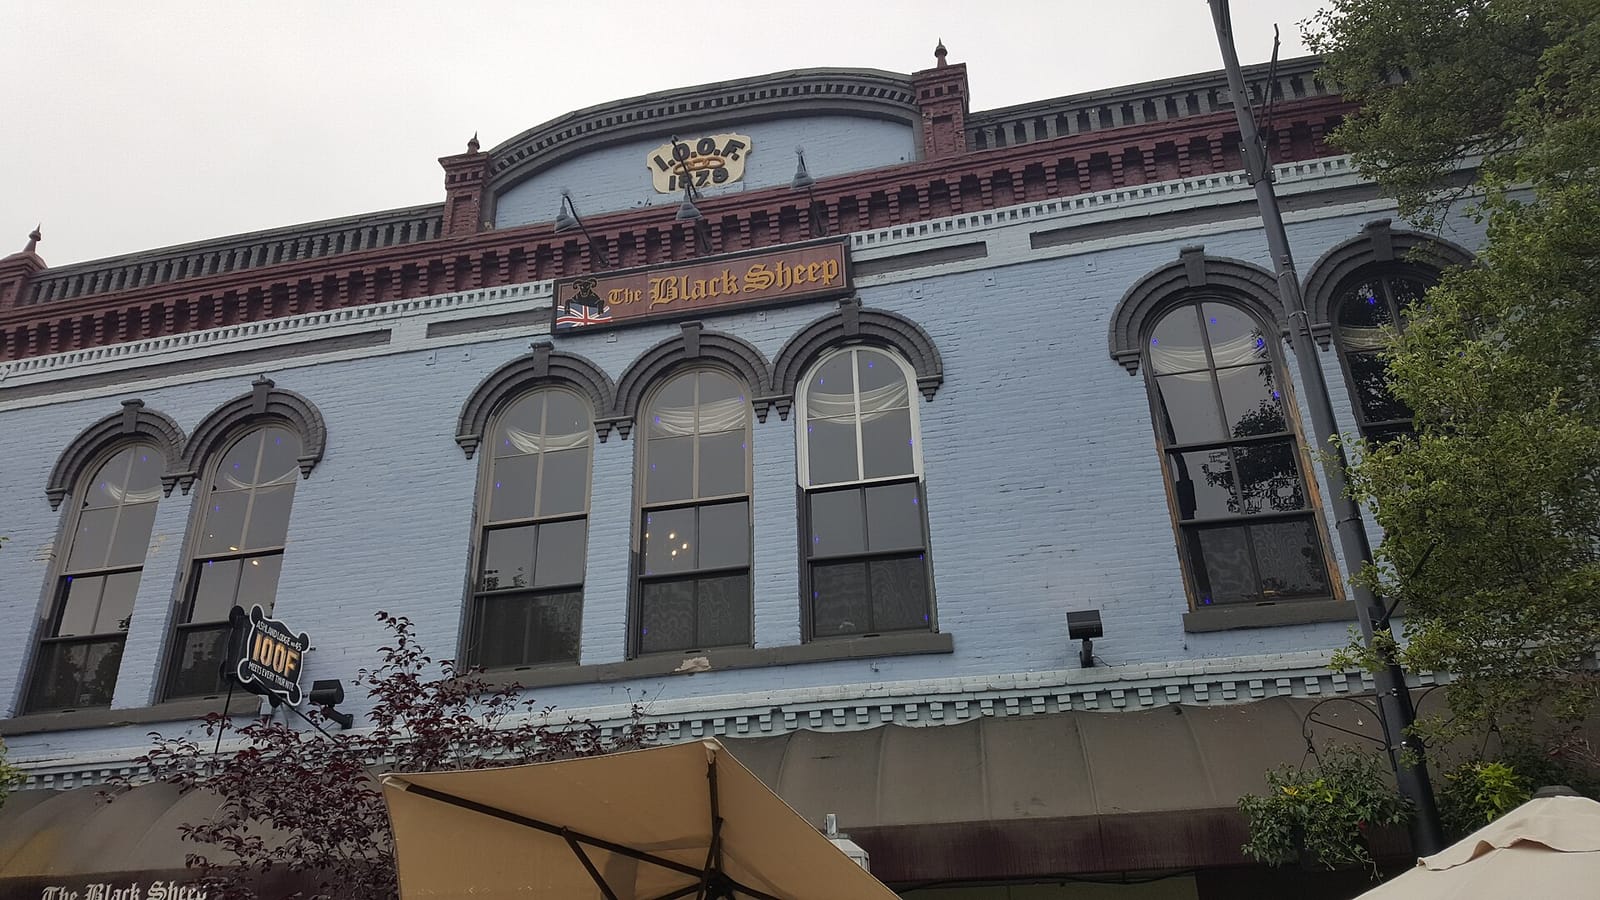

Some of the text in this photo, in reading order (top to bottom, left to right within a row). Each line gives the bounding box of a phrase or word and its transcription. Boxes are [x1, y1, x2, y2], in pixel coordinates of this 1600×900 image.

[607, 257, 840, 310] The Black Sheep
[256, 620, 278, 638] ASHLAND
[276, 631, 290, 646] LODGE
[252, 632, 300, 678] IOOF
[248, 661, 262, 675] MEETS
[261, 668, 275, 681] EVERY
[41, 886, 79, 900] The
[84, 881, 141, 900] Black
